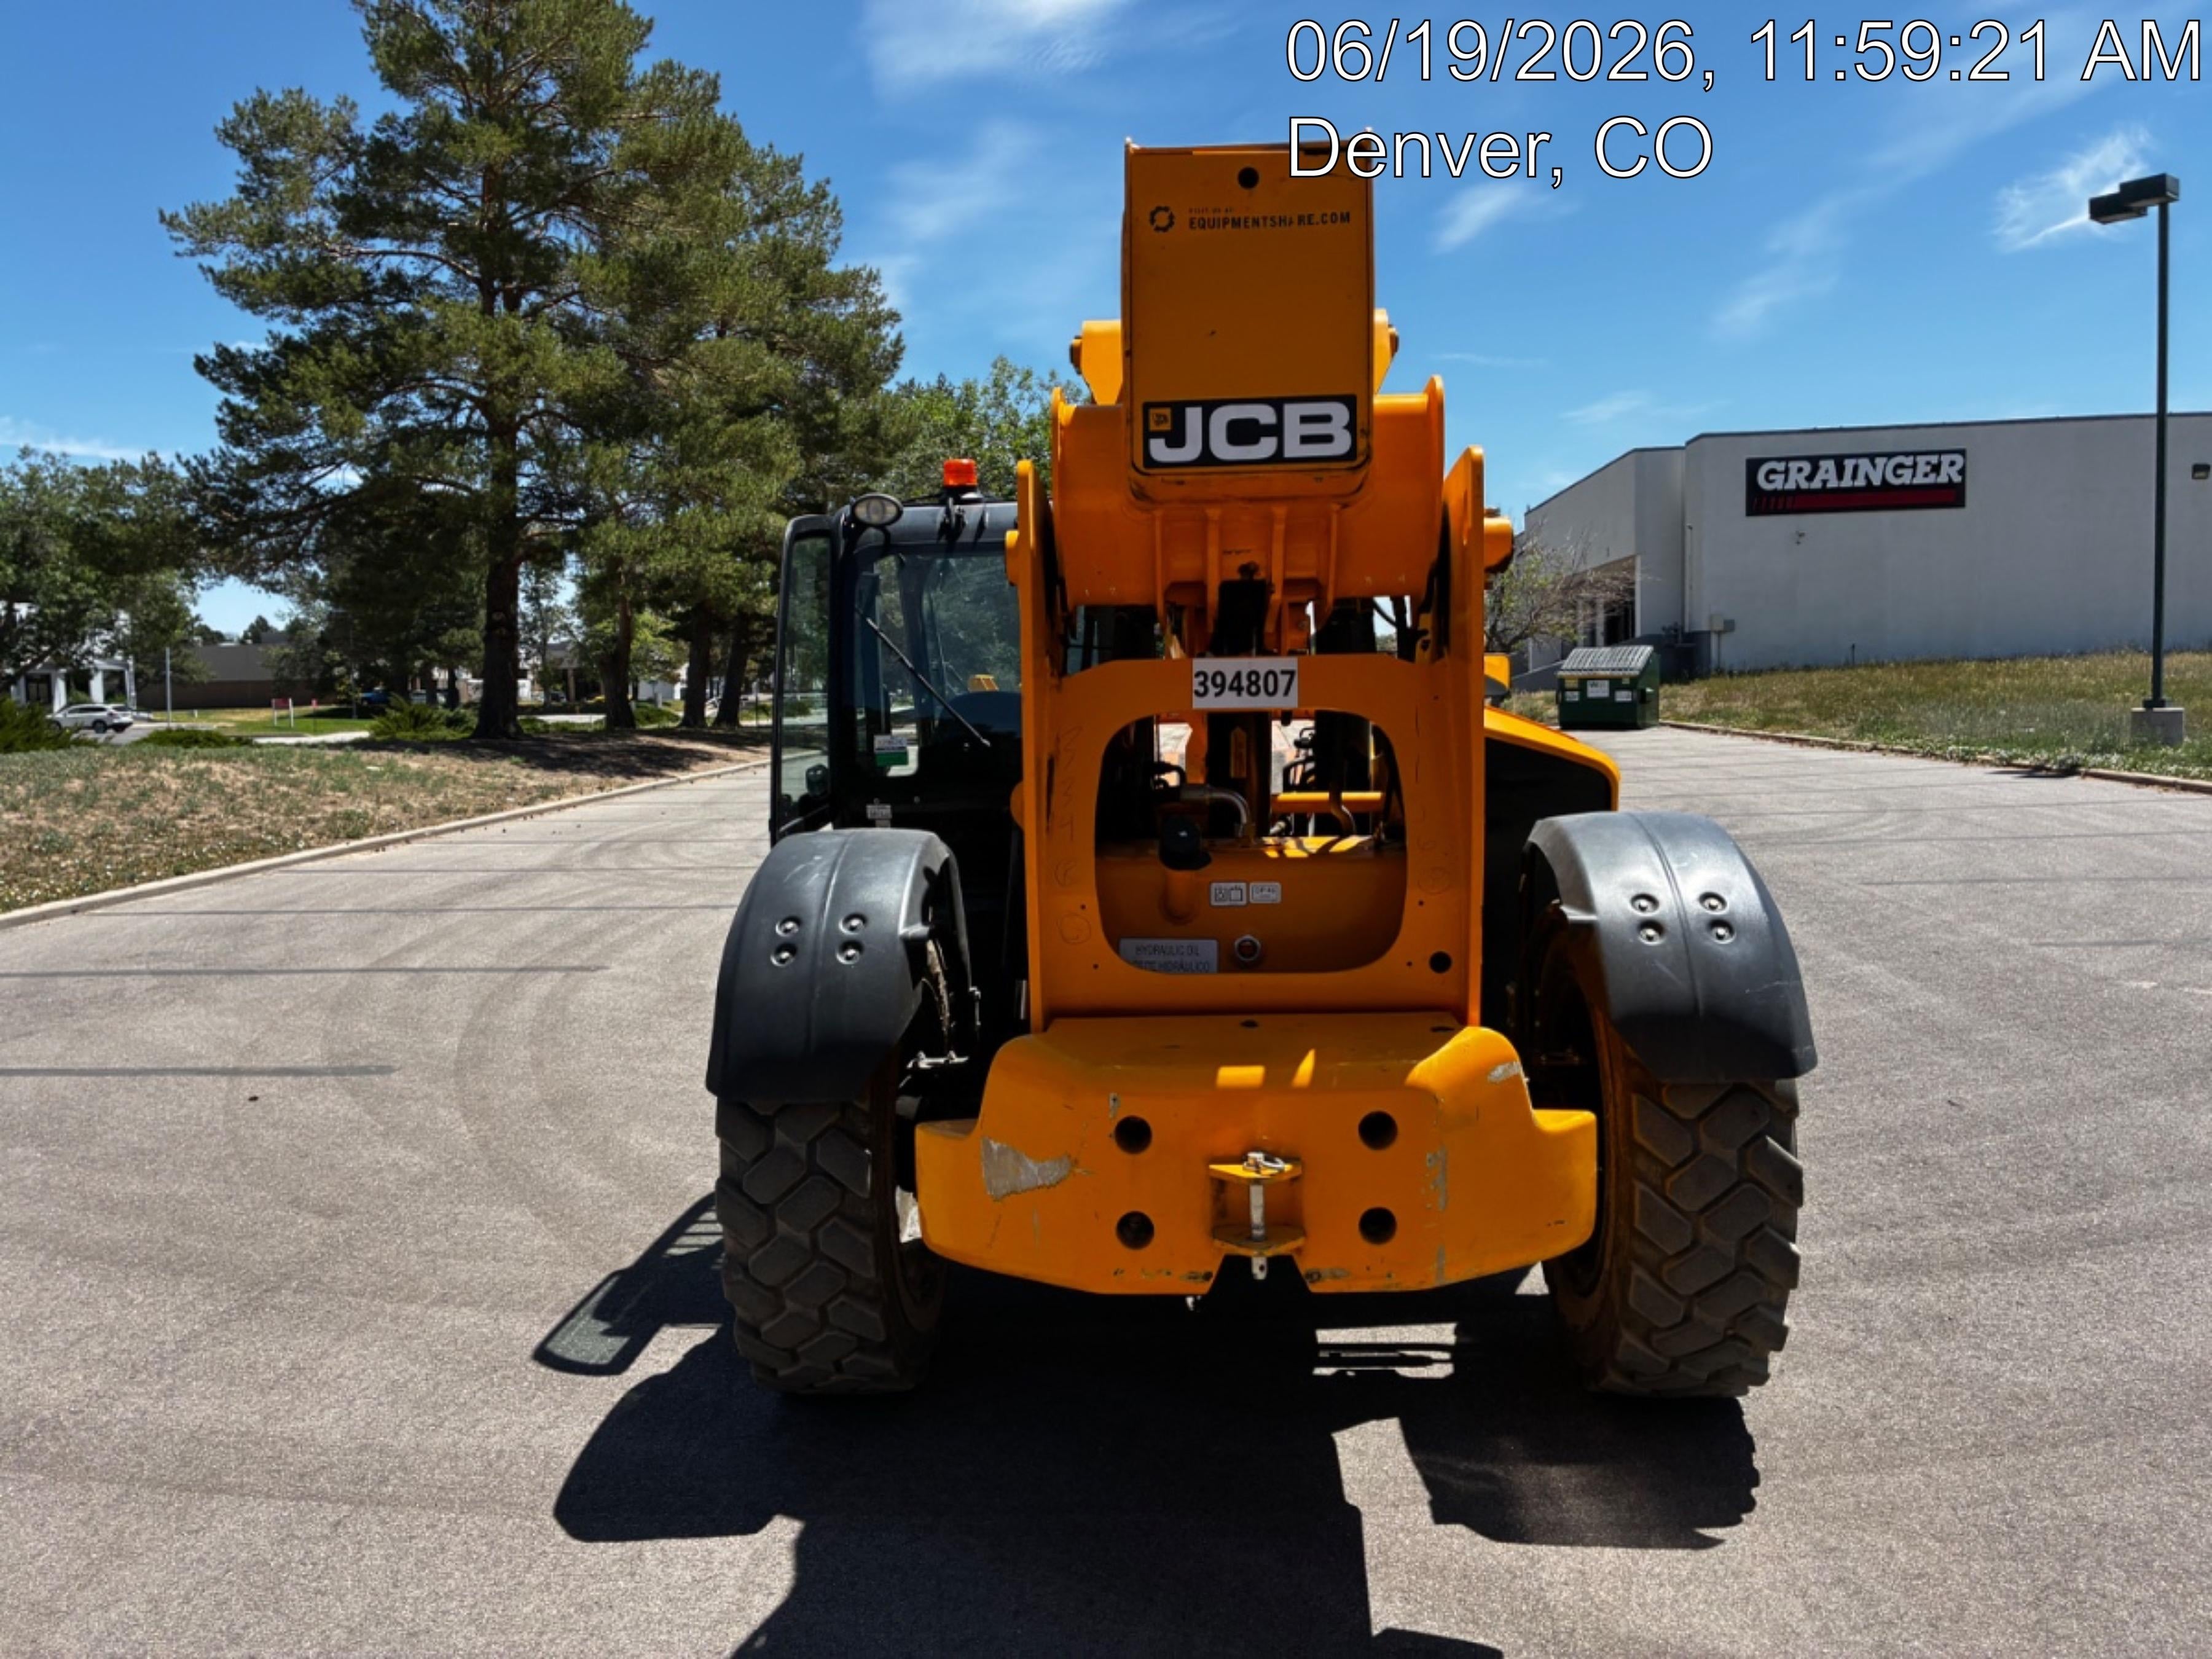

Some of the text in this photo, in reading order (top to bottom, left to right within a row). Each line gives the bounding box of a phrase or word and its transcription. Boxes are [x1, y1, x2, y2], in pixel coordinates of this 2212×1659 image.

[1148, 401, 1352, 463] JCB
[1757, 453, 1964, 491] GRAINGER
[1194, 669, 1296, 698] 394807
[1135, 944, 1184, 956] HYDRAULIC
